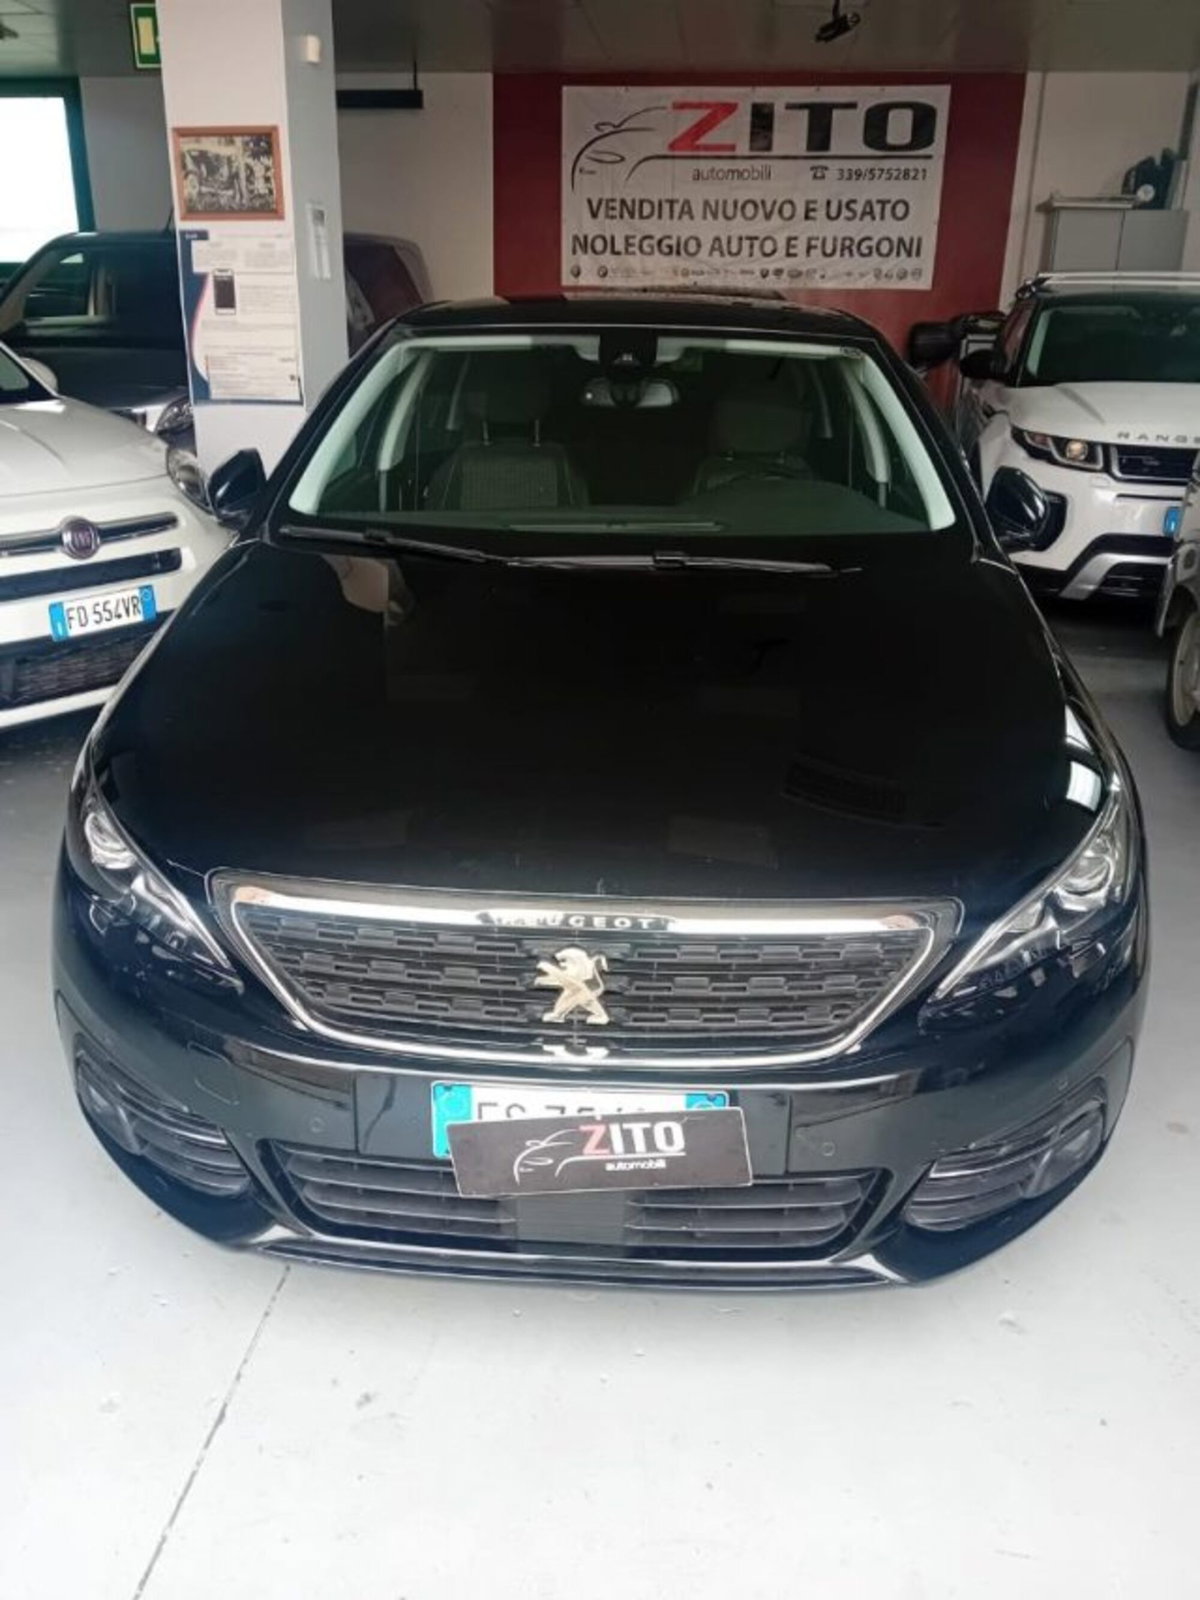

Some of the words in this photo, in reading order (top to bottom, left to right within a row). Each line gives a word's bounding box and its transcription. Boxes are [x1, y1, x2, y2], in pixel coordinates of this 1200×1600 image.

[667, 101, 938, 153] ZITO
[692, 165, 772, 181] automobili
[836, 167, 928, 182] 339/5752821
[586, 198, 694, 221] VENDITA
[702, 198, 797, 222] NUOVO
[804, 199, 817, 222] E
[825, 199, 910, 222] USATO
[571, 234, 702, 258] NOLEGGIO
[708, 235, 780, 258] AUTO
[785, 236, 799, 258] E
[805, 236, 922, 259] FURGONI
[500, 913, 654, 930] UGEOT
[579, 1121, 685, 1155] ZITO
